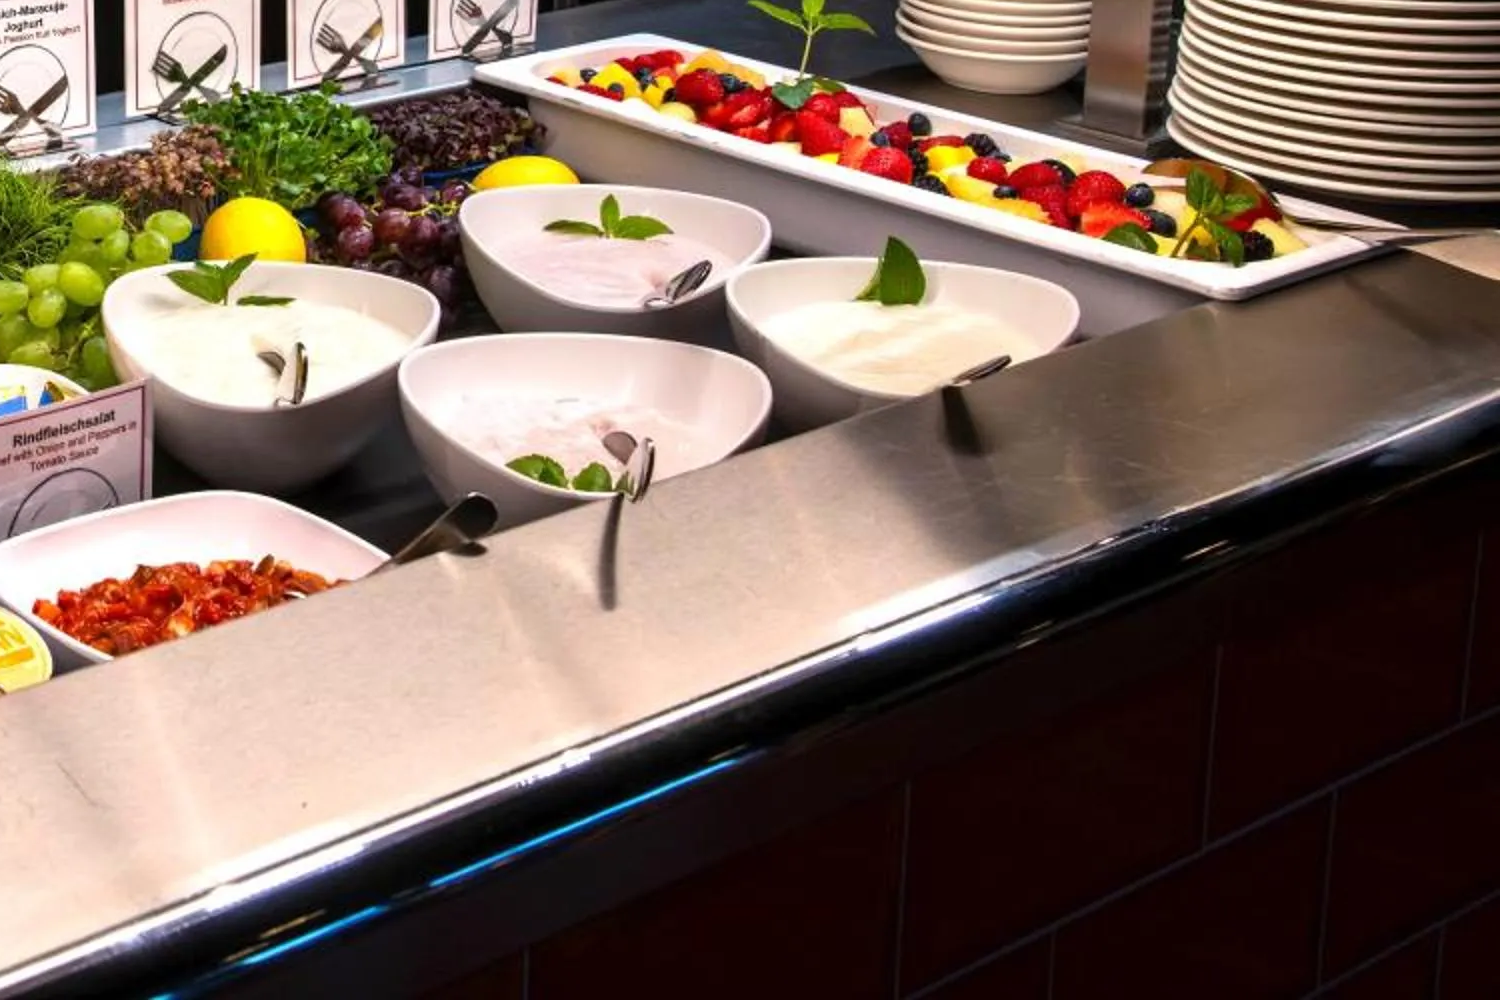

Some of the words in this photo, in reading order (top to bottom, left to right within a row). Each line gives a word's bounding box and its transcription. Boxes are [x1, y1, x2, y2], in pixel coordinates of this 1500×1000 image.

[3, 18, 44, 33] Joghurt
[11, 408, 116, 449] Rindfleischsalat
[13, 449, 33, 462] with
[67, 435, 86, 447] and
[29, 457, 67, 473] Tomato
